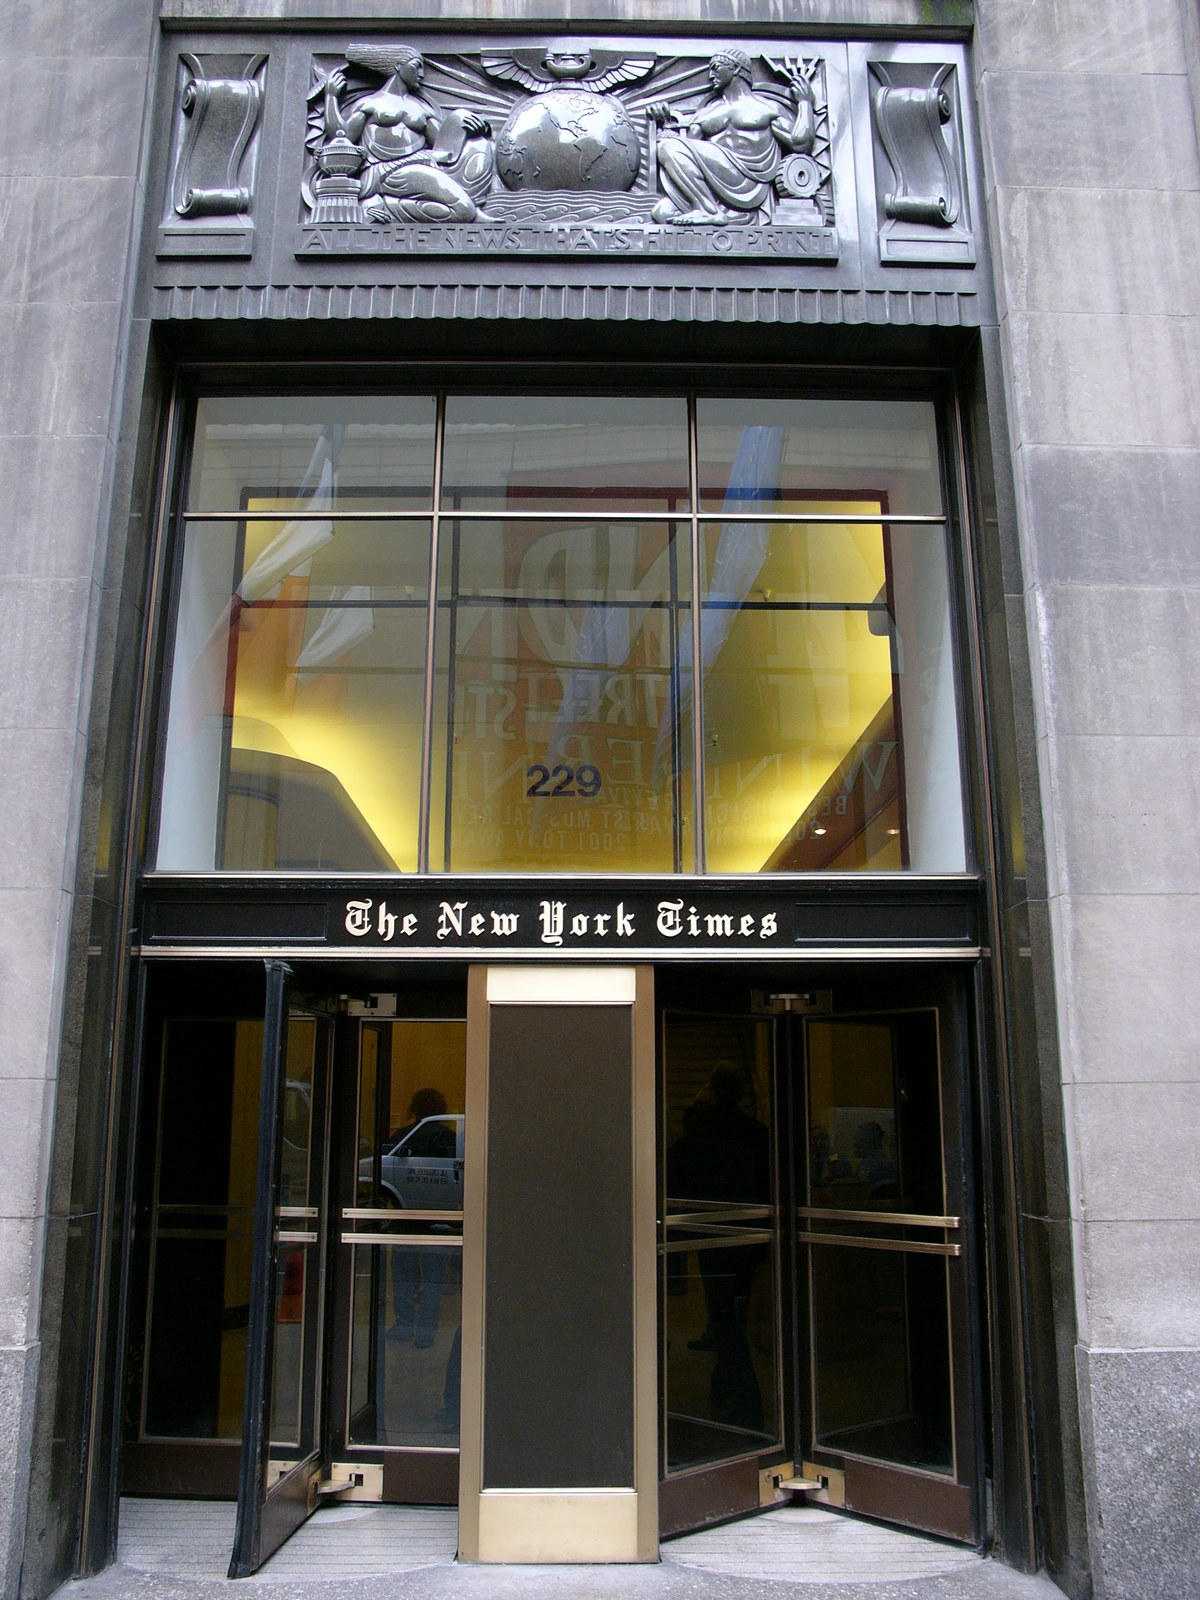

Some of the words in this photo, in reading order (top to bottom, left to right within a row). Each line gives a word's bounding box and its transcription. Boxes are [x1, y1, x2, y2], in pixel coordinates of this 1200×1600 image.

[371, 228, 431, 250] THE
[440, 228, 521, 250] NEWS
[691, 229, 735, 252] TO
[741, 230, 834, 253] PRINT
[526, 764, 602, 797] 229
[344, 898, 418, 941] The
[436, 900, 520, 940] New
[539, 900, 636, 946] York
[656, 898, 778, 940] Times
